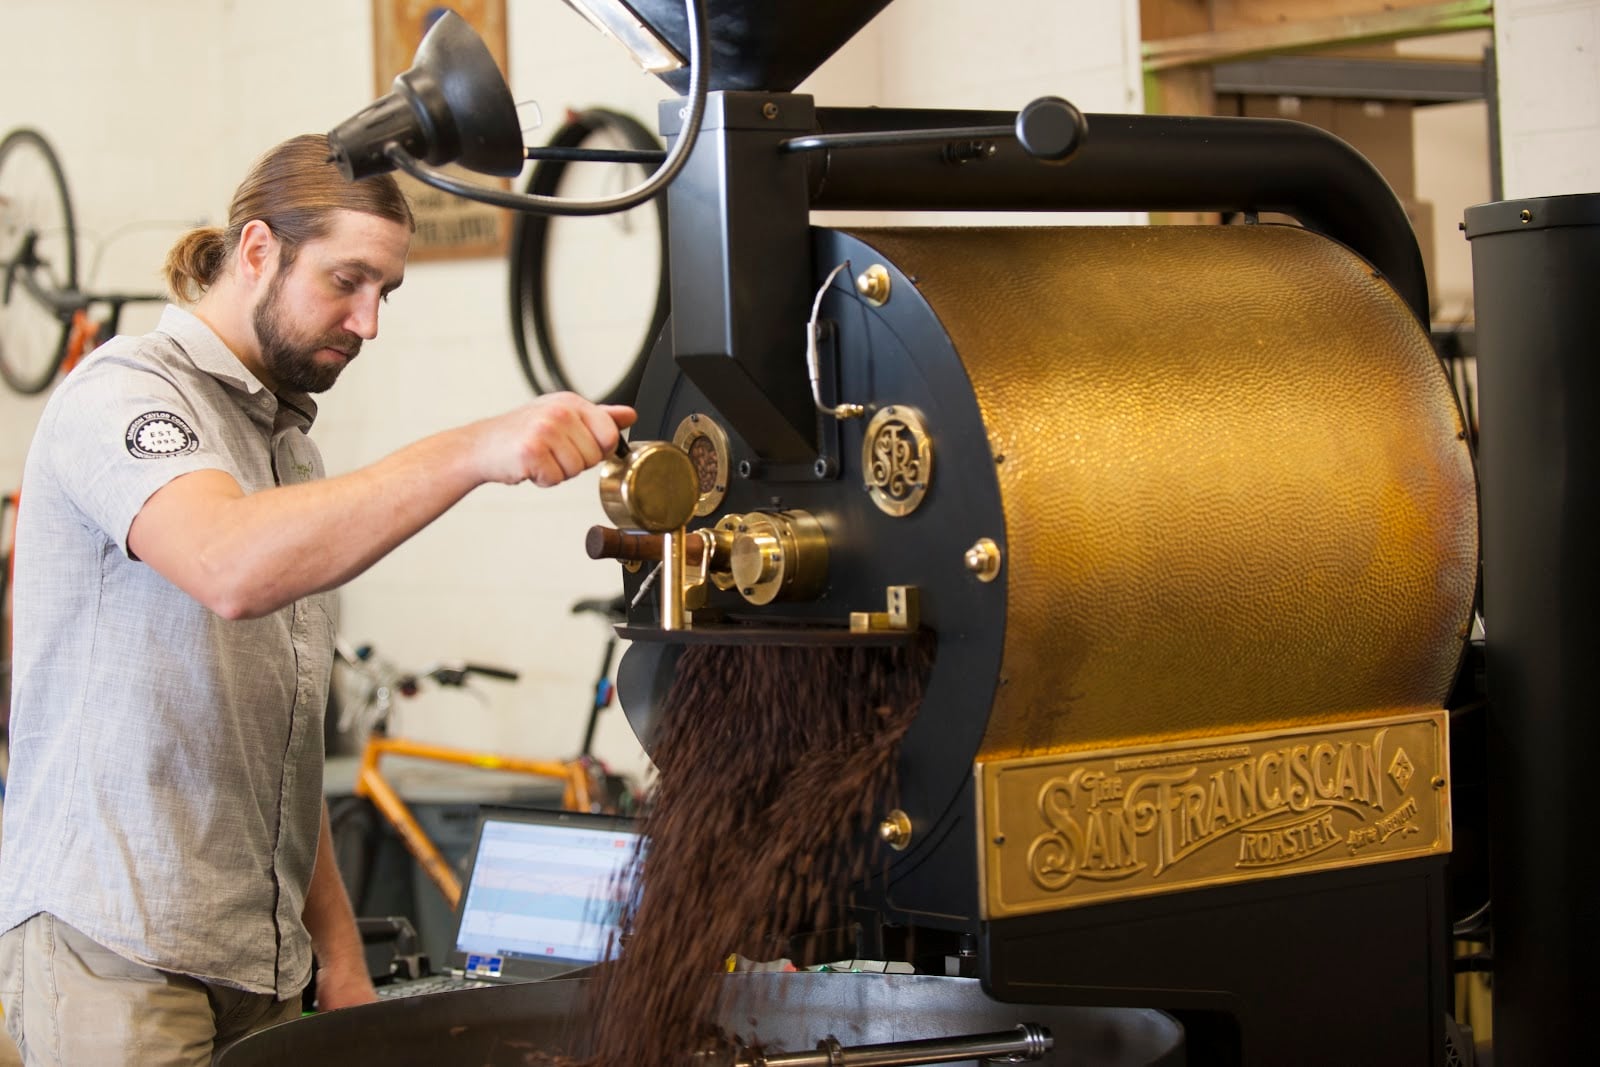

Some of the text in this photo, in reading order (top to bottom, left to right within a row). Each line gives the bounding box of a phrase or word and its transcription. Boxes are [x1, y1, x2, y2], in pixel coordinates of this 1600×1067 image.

[143, 412, 170, 420] TAYLOR
[171, 416, 192, 433] COFFEE
[152, 438, 176, 446] 1995
[1079, 771, 1124, 807] THE
[1027, 728, 1389, 891] SAN FRANCISCAN
[1240, 812, 1341, 862] ROASTER
